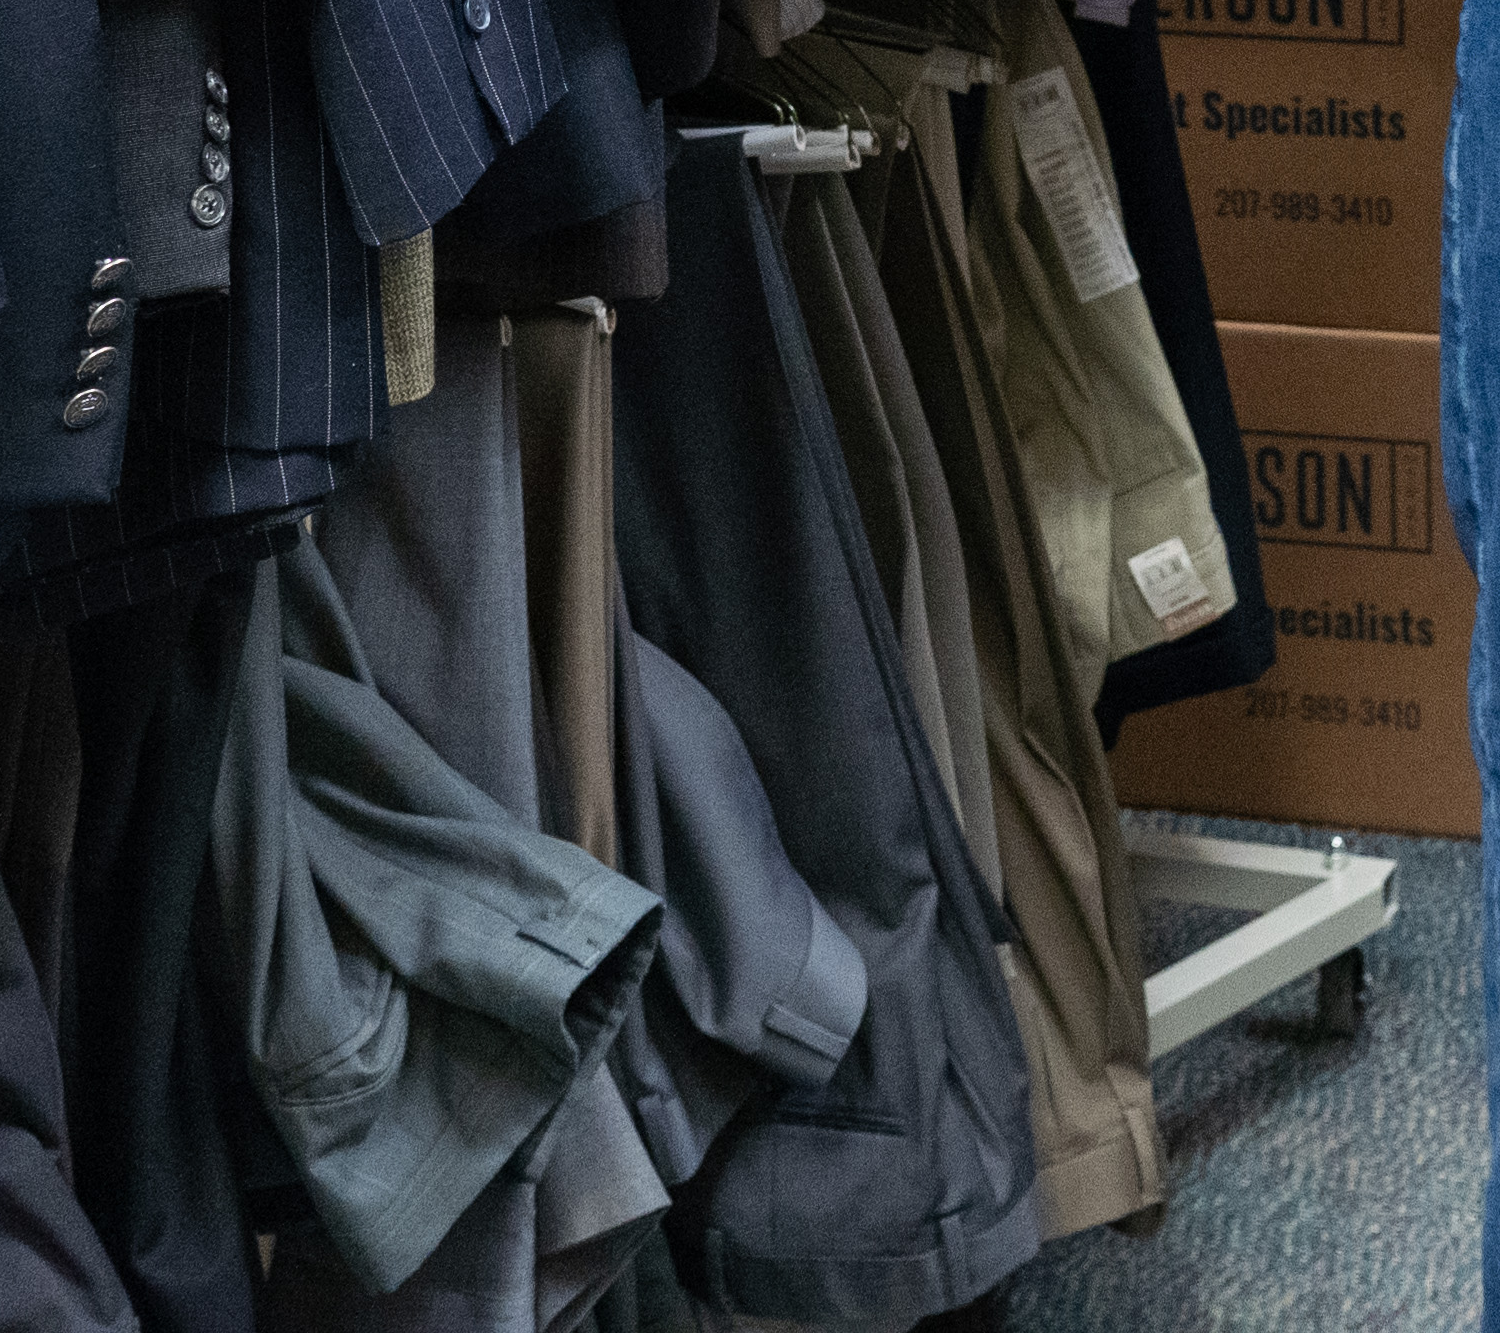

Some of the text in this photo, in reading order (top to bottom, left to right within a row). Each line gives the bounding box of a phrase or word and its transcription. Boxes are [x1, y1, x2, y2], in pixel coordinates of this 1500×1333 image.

[1202, 90, 1406, 142] Specialists
[1214, 186, 1394, 227] 207-989-3410
[1257, 447, 1371, 534] SON
